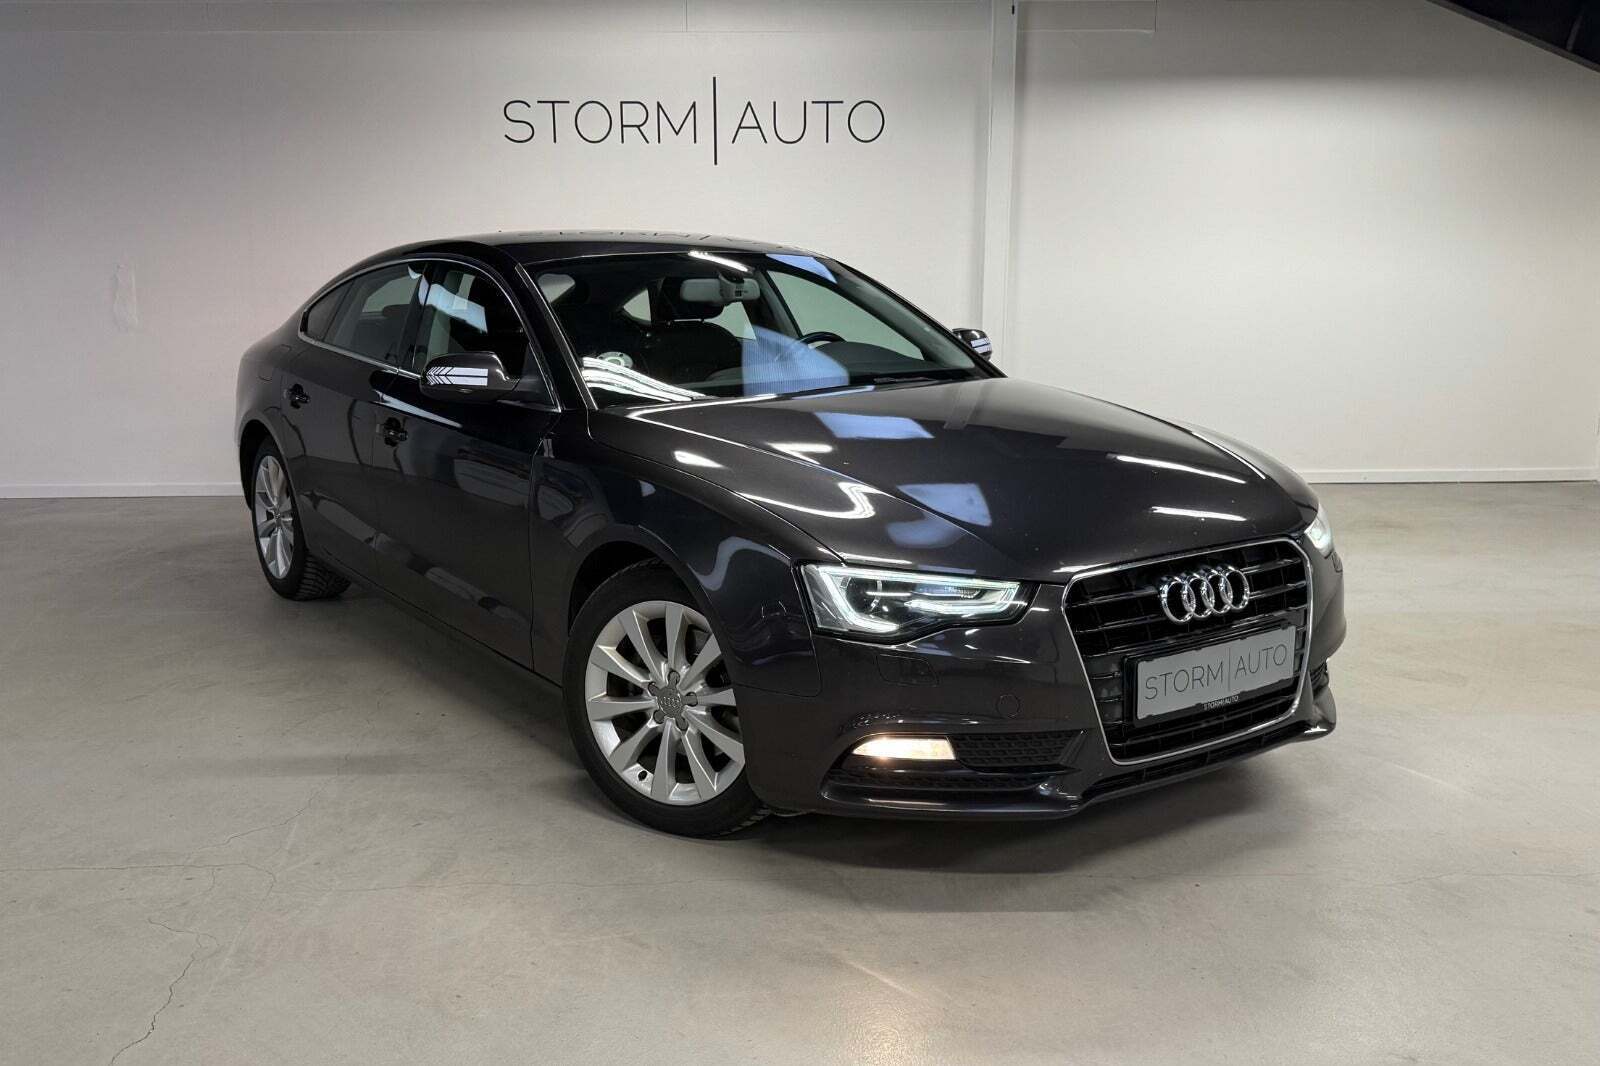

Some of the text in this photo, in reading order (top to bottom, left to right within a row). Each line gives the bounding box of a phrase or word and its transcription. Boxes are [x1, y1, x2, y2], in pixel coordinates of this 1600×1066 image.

[503, 99, 886, 145] STORM AUTO
[1145, 643, 1288, 700] STORM AUTO
